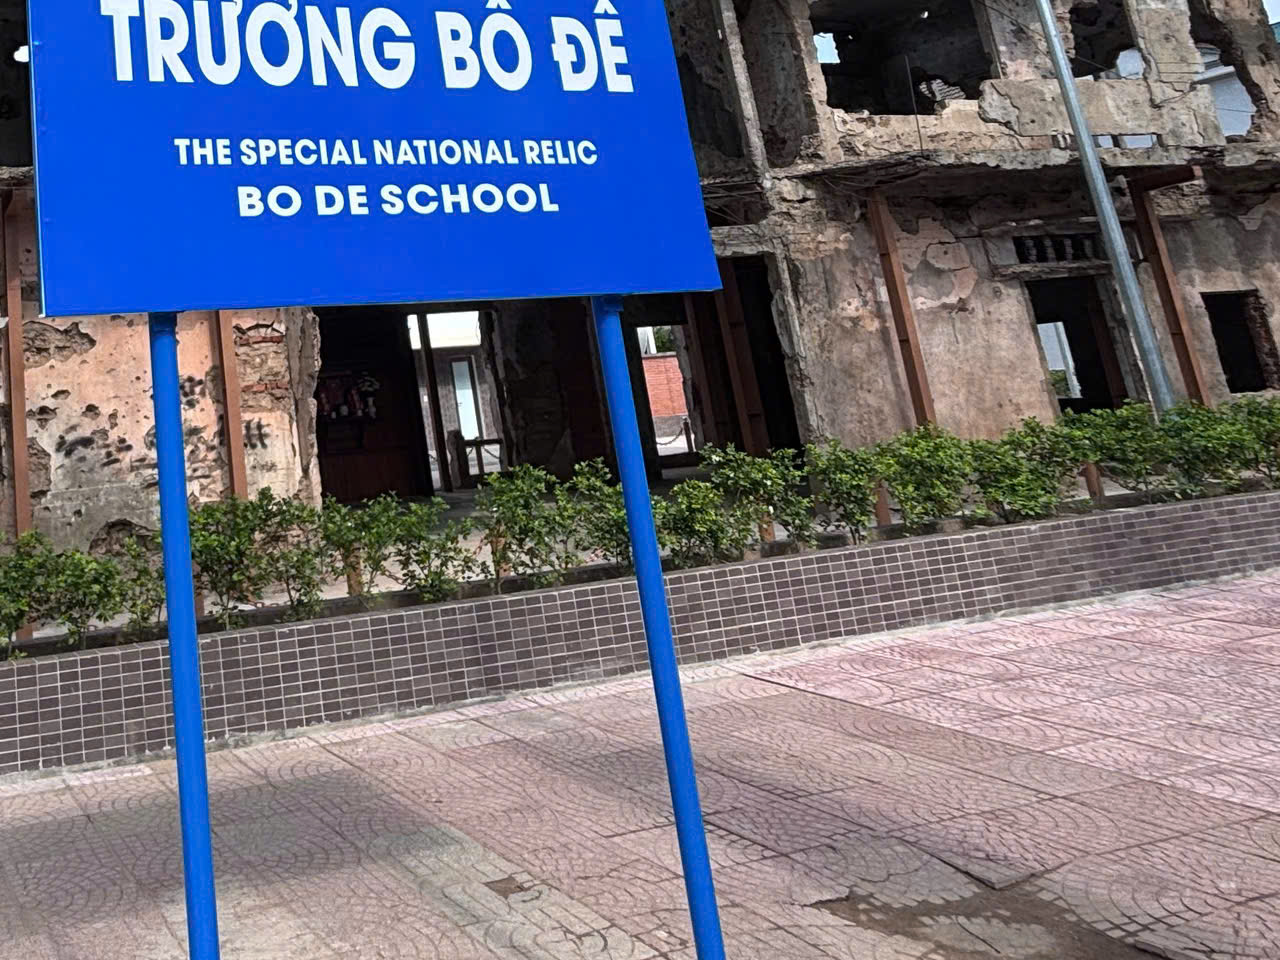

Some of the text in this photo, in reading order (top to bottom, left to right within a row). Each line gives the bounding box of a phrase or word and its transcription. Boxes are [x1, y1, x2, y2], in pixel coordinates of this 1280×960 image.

[173, 138, 598, 166] THE SPECIAL NATIONAL RELIC
[237, 183, 560, 217] BO DE SCHOOL
